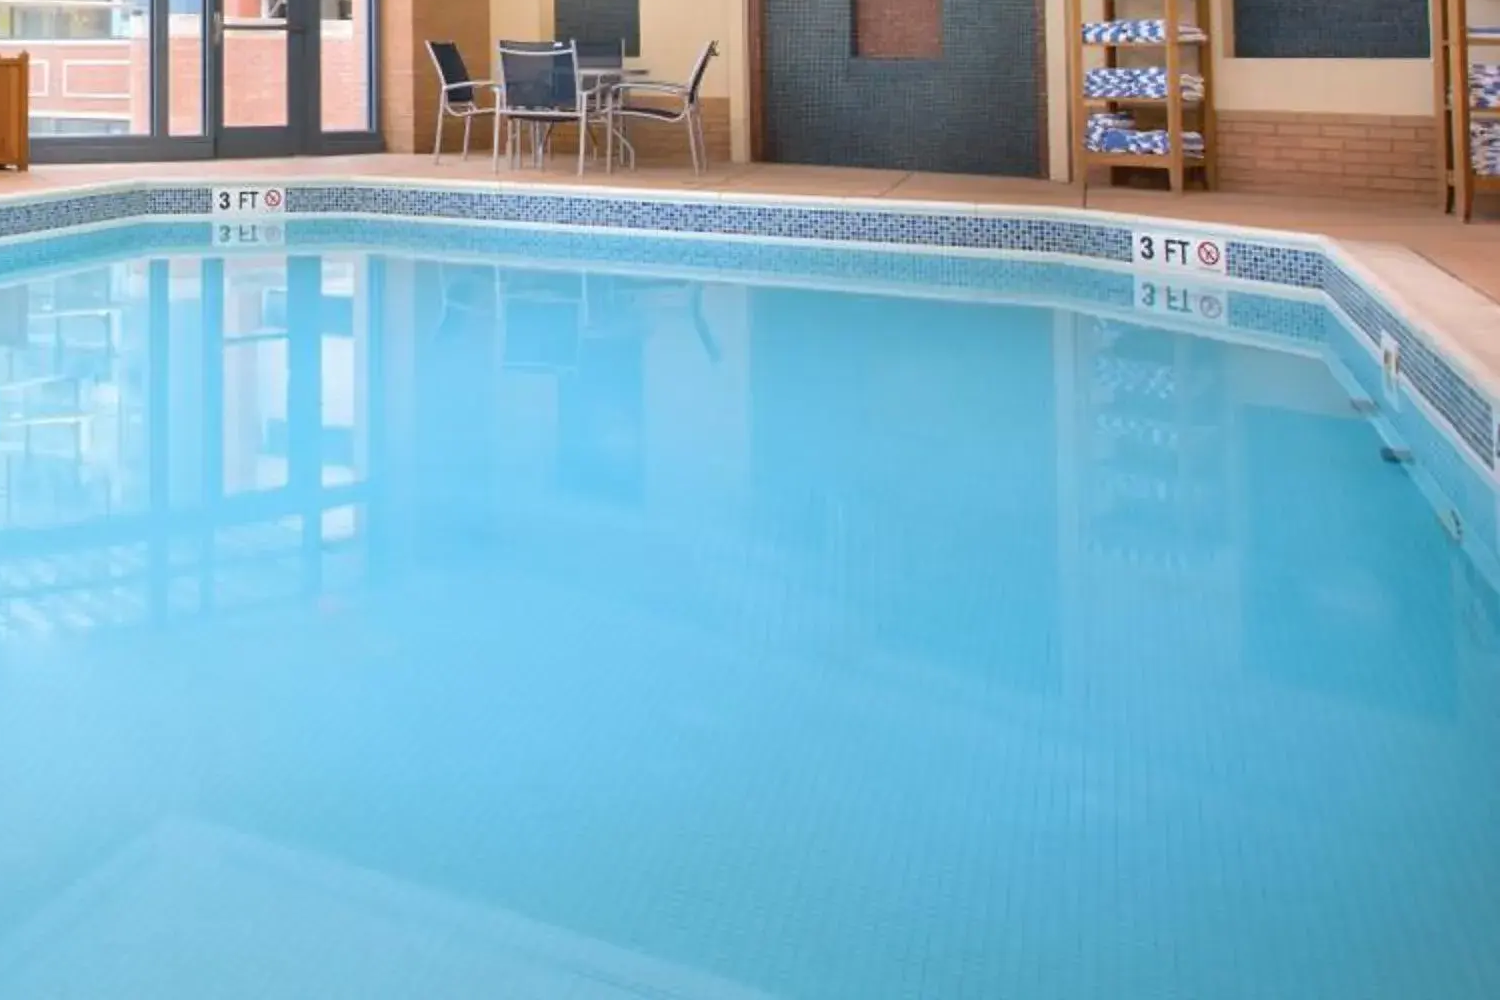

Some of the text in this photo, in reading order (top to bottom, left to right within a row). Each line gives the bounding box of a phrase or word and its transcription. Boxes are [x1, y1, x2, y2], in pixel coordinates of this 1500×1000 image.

[219, 191, 259, 210] 3 FT
[1140, 236, 1190, 265] 3 FT
